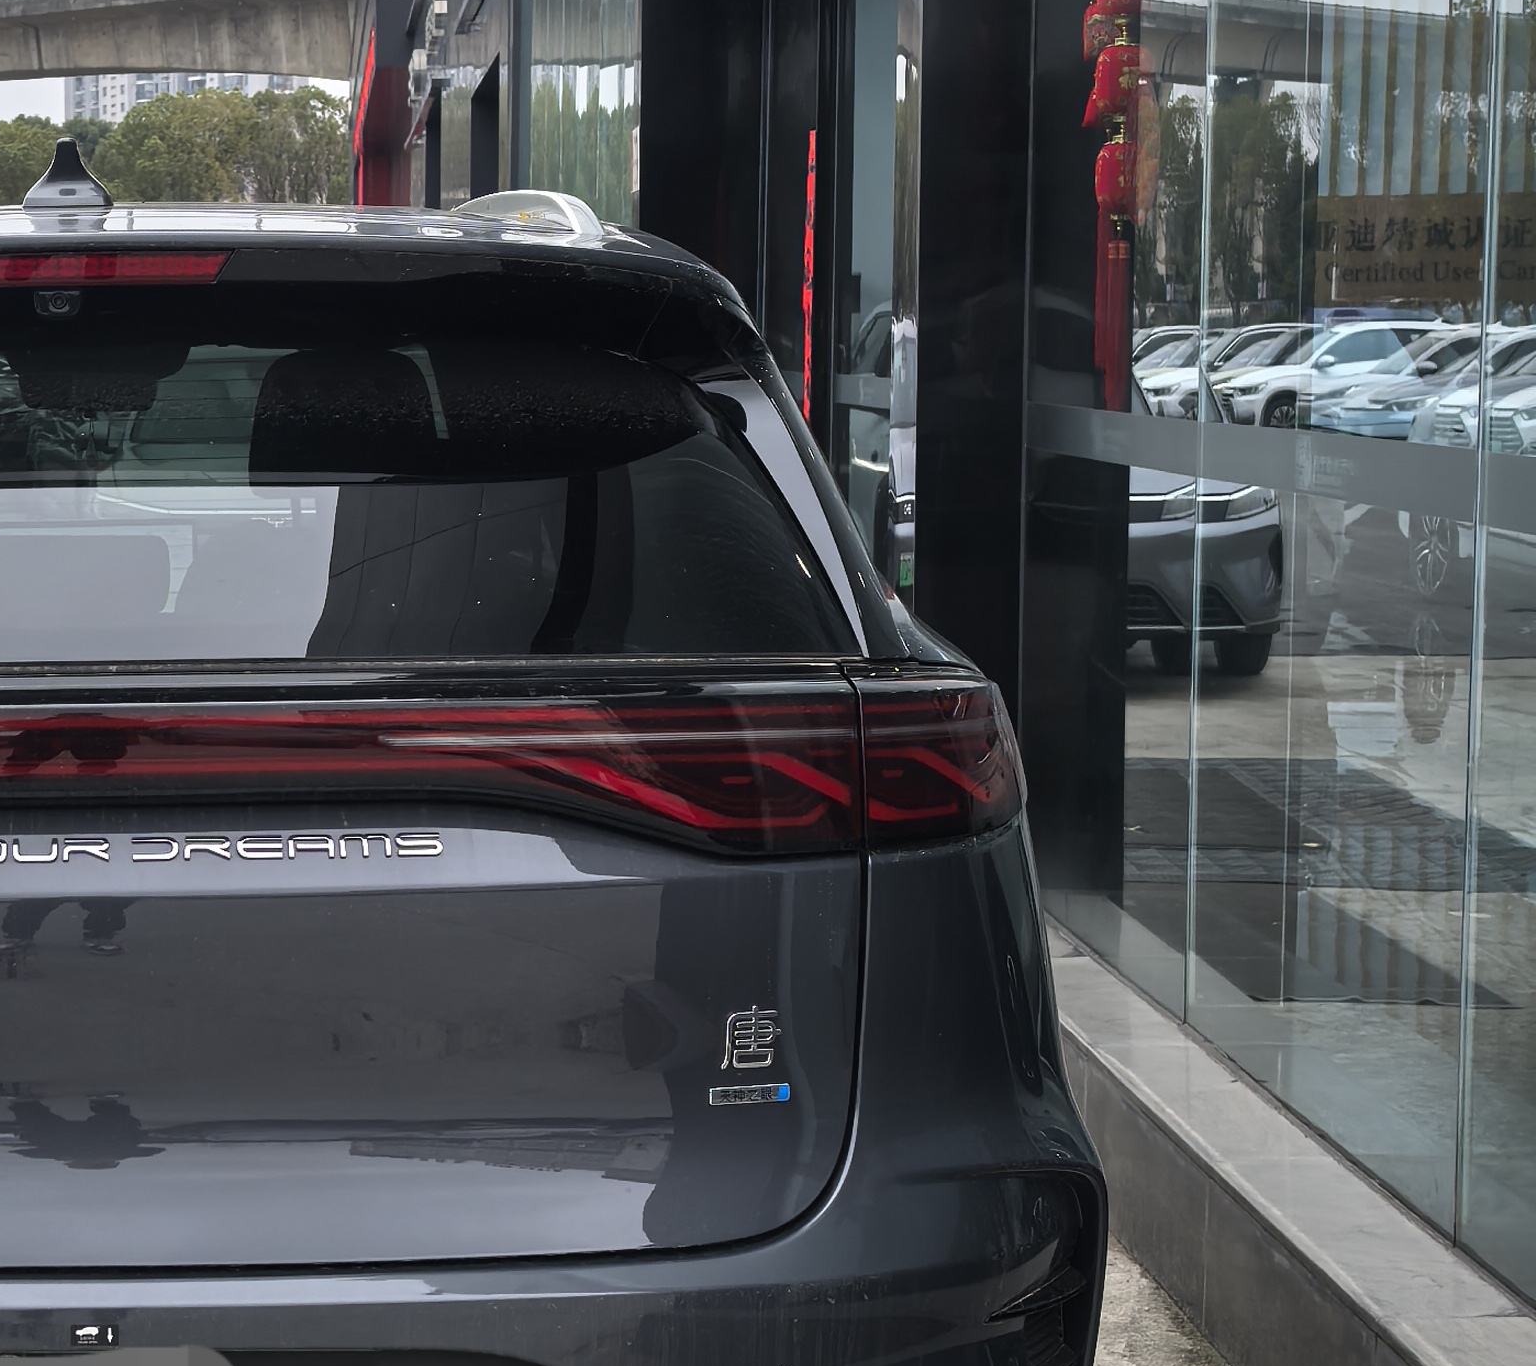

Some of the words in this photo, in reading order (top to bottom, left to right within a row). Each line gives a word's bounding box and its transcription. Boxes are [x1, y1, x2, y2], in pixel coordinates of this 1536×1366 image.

[1433, 261, 1486, 282] Use
[130, 832, 445, 863] DREAMS
[720, 1004, 782, 1070] 唐
